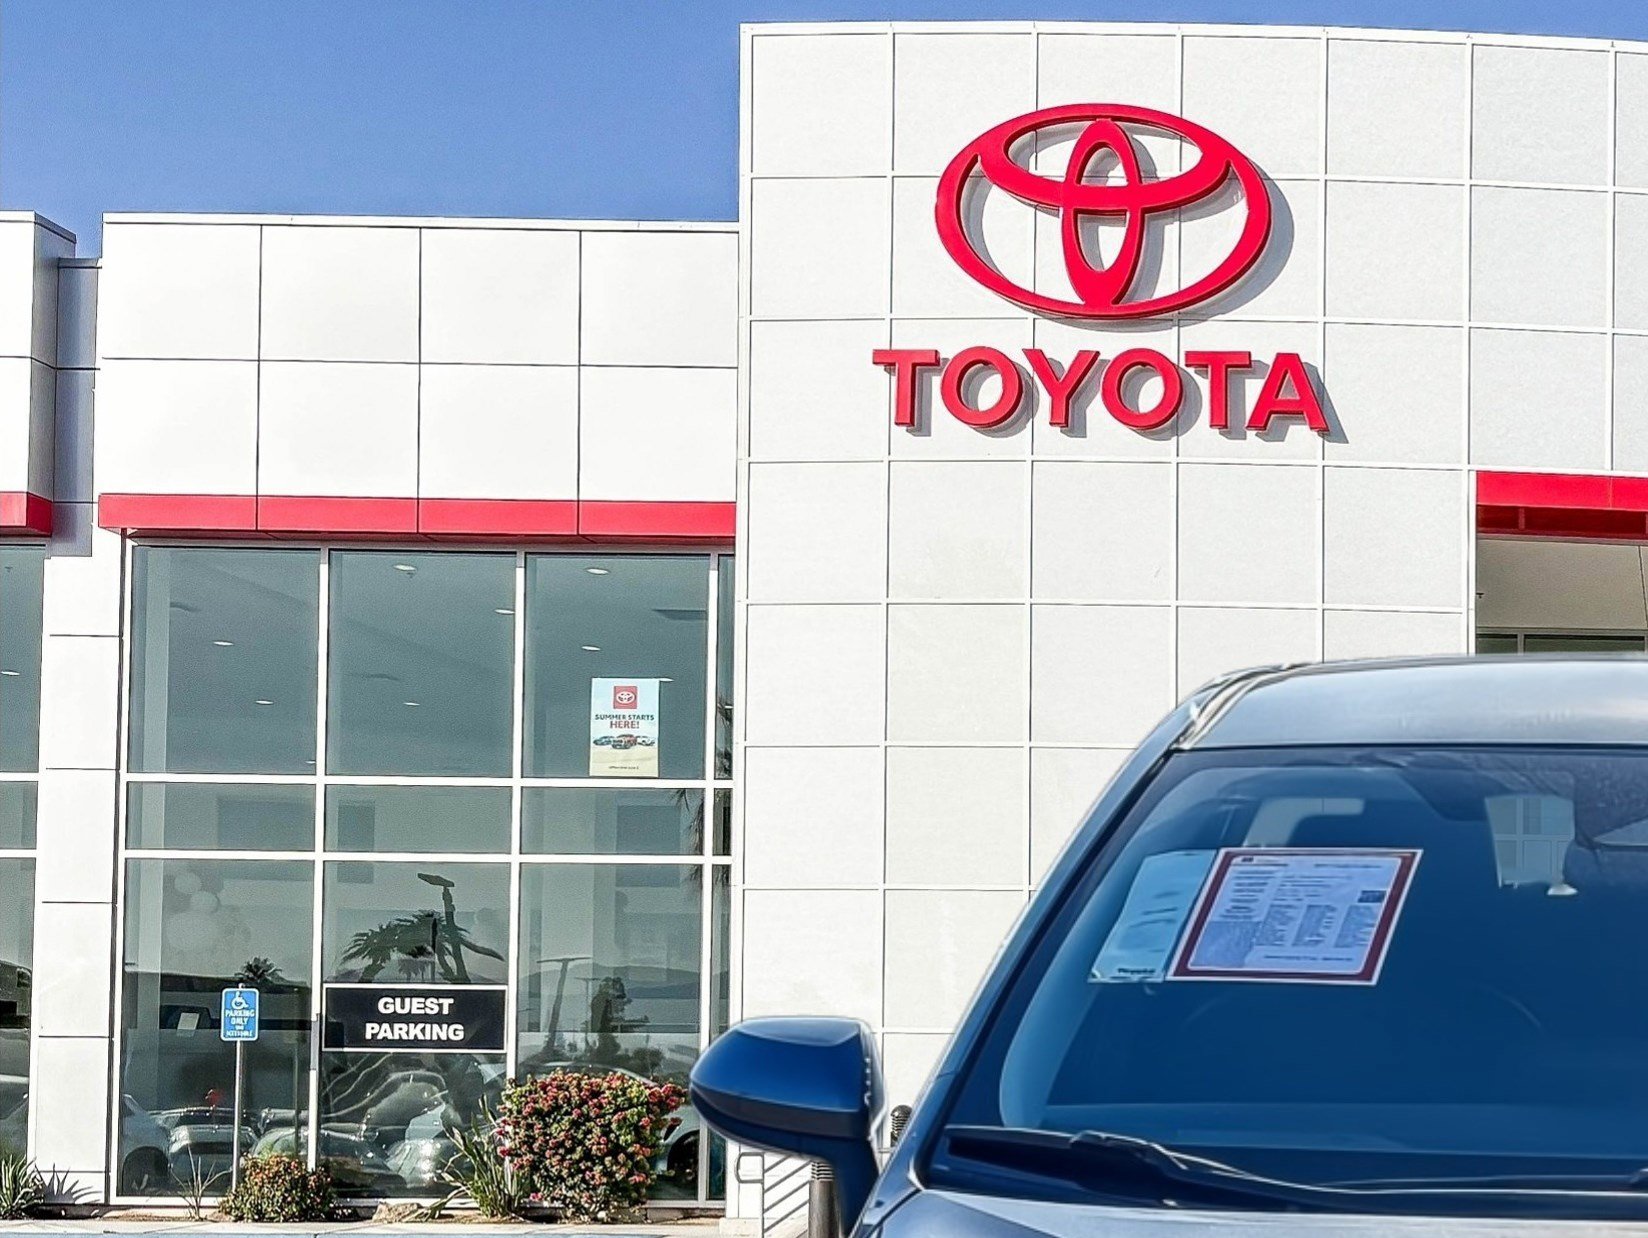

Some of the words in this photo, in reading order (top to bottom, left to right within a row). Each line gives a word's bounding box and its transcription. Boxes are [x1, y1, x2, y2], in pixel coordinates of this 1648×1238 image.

[872, 346, 1331, 434] TOYOTA
[609, 720, 640, 729] HERE!
[225, 1009, 256, 1017] PARKING
[377, 997, 455, 1015] GUEST
[365, 1022, 465, 1041] PARKING
